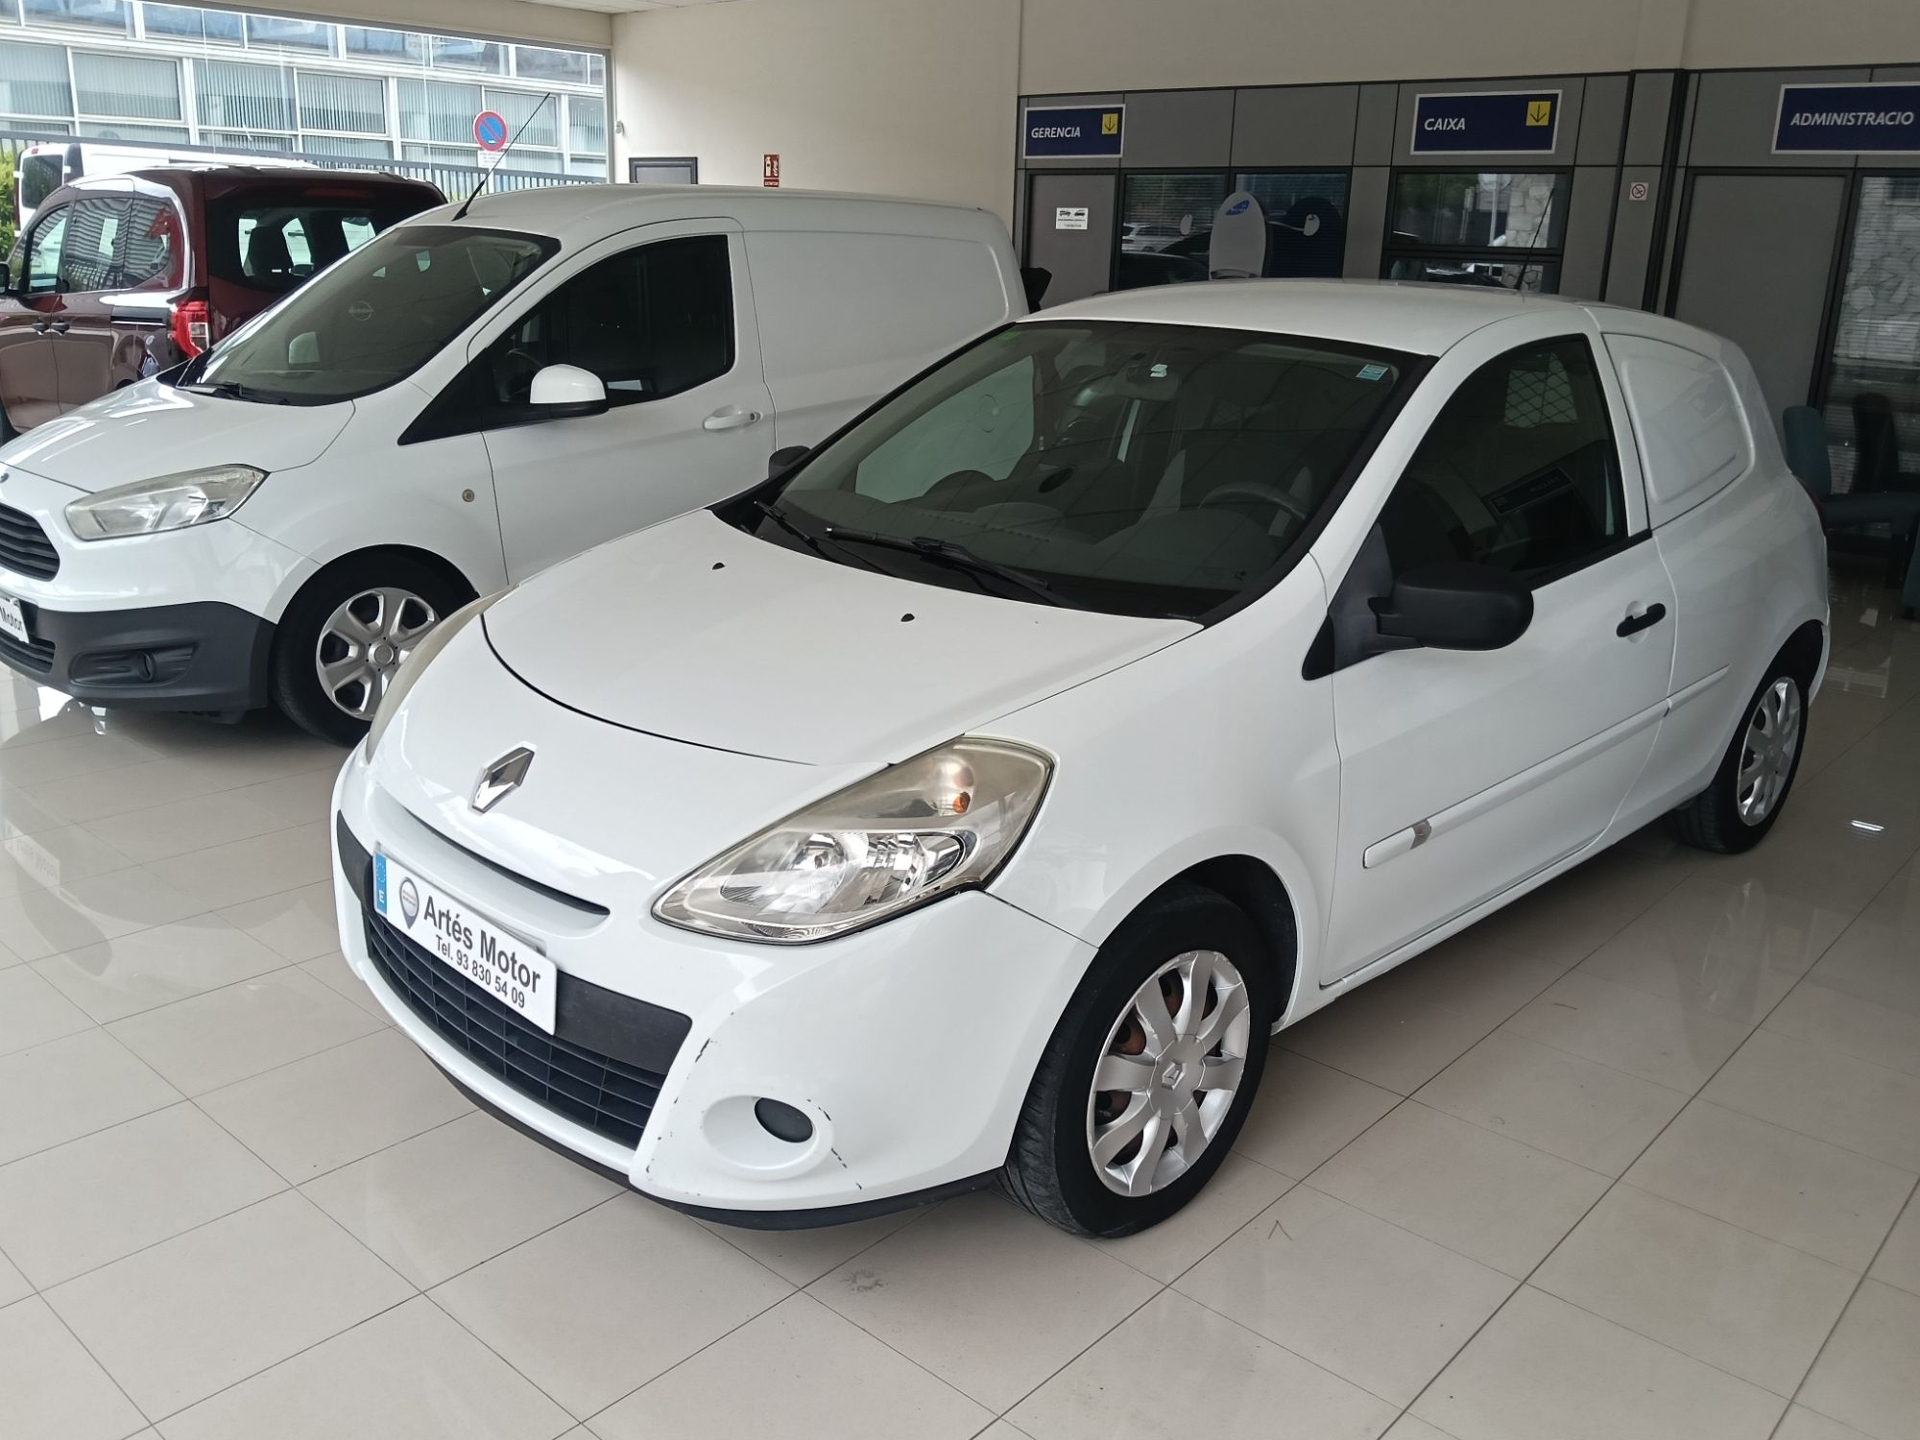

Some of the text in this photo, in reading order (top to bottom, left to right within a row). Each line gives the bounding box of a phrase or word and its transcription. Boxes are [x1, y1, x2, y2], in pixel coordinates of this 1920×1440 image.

[1424, 117, 1466, 131] CAIXA
[1789, 111, 1915, 126] ADMINISTRACIO
[1031, 126, 1081, 138] GERENCIA
[378, 889, 385, 904] E
[423, 895, 541, 993] Artés Motor
[435, 934, 525, 1009] Tel. 93 830 54 09
